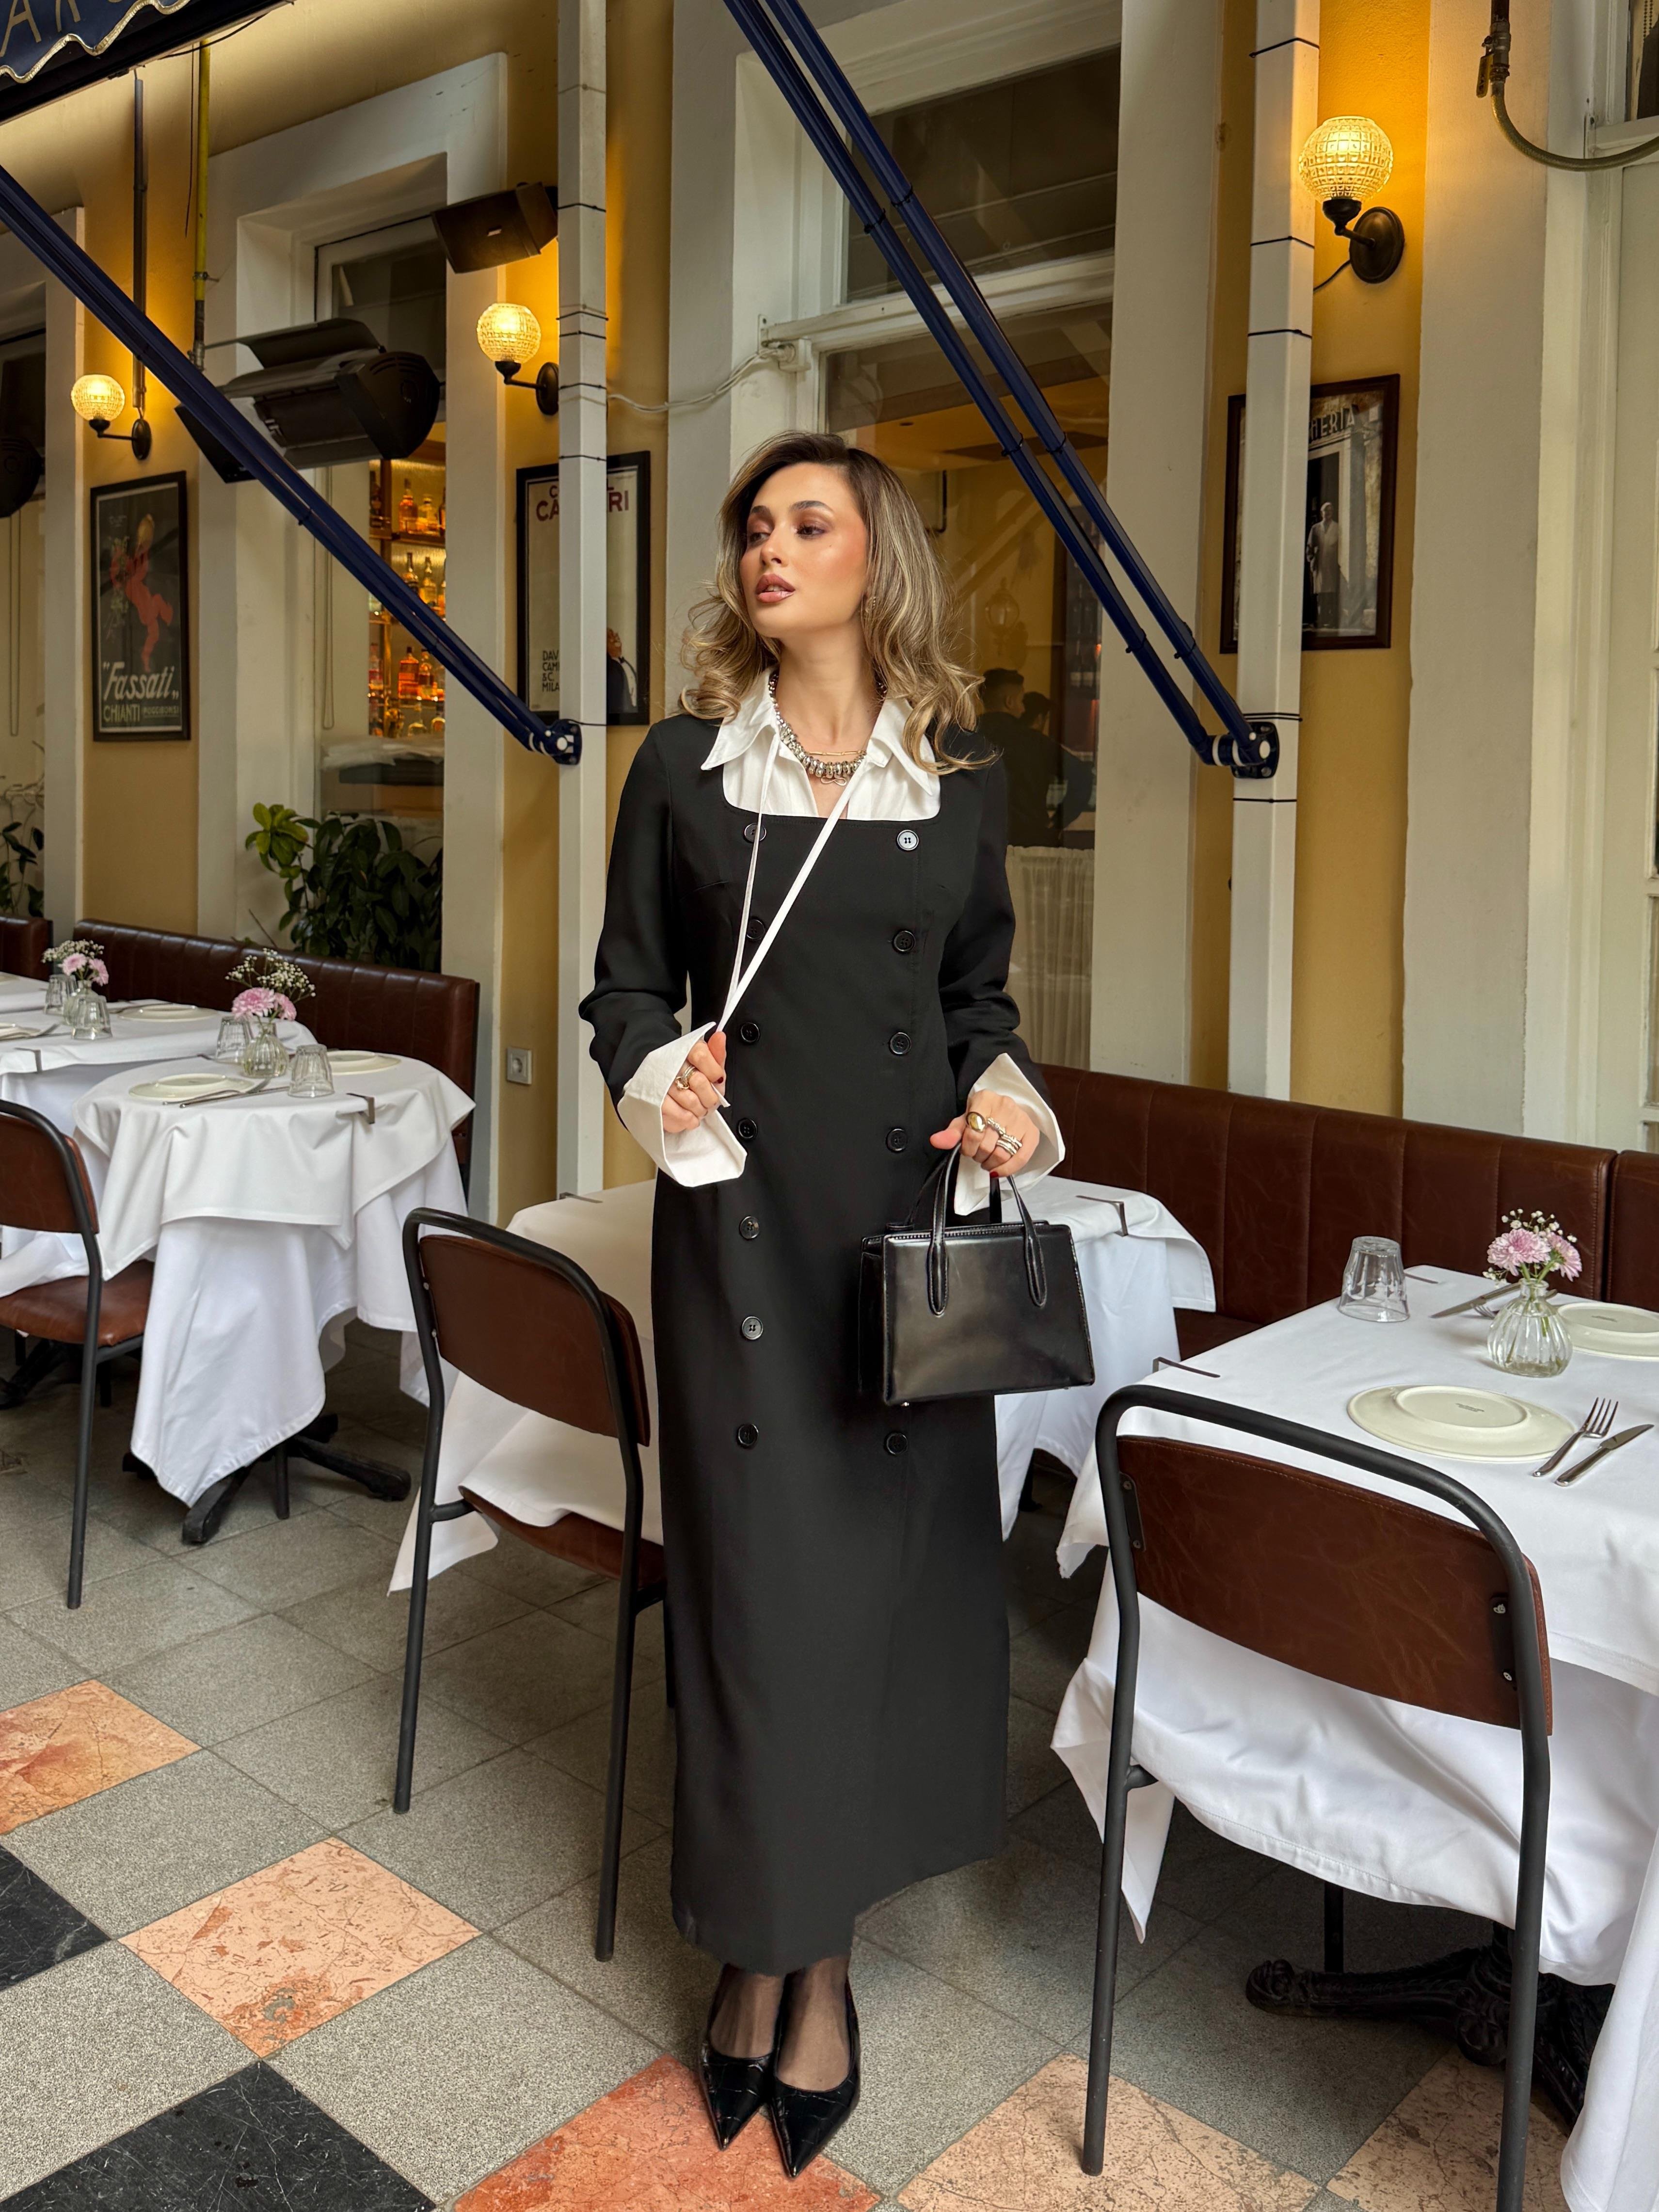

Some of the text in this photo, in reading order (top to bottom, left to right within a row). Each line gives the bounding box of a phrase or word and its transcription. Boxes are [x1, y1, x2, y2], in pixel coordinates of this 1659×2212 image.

[1310, 403, 1356, 441] HERIA
[542, 650, 559, 661] DAV
[542, 682, 559, 692] MILA
[103, 704, 140, 722] CHIANTI
